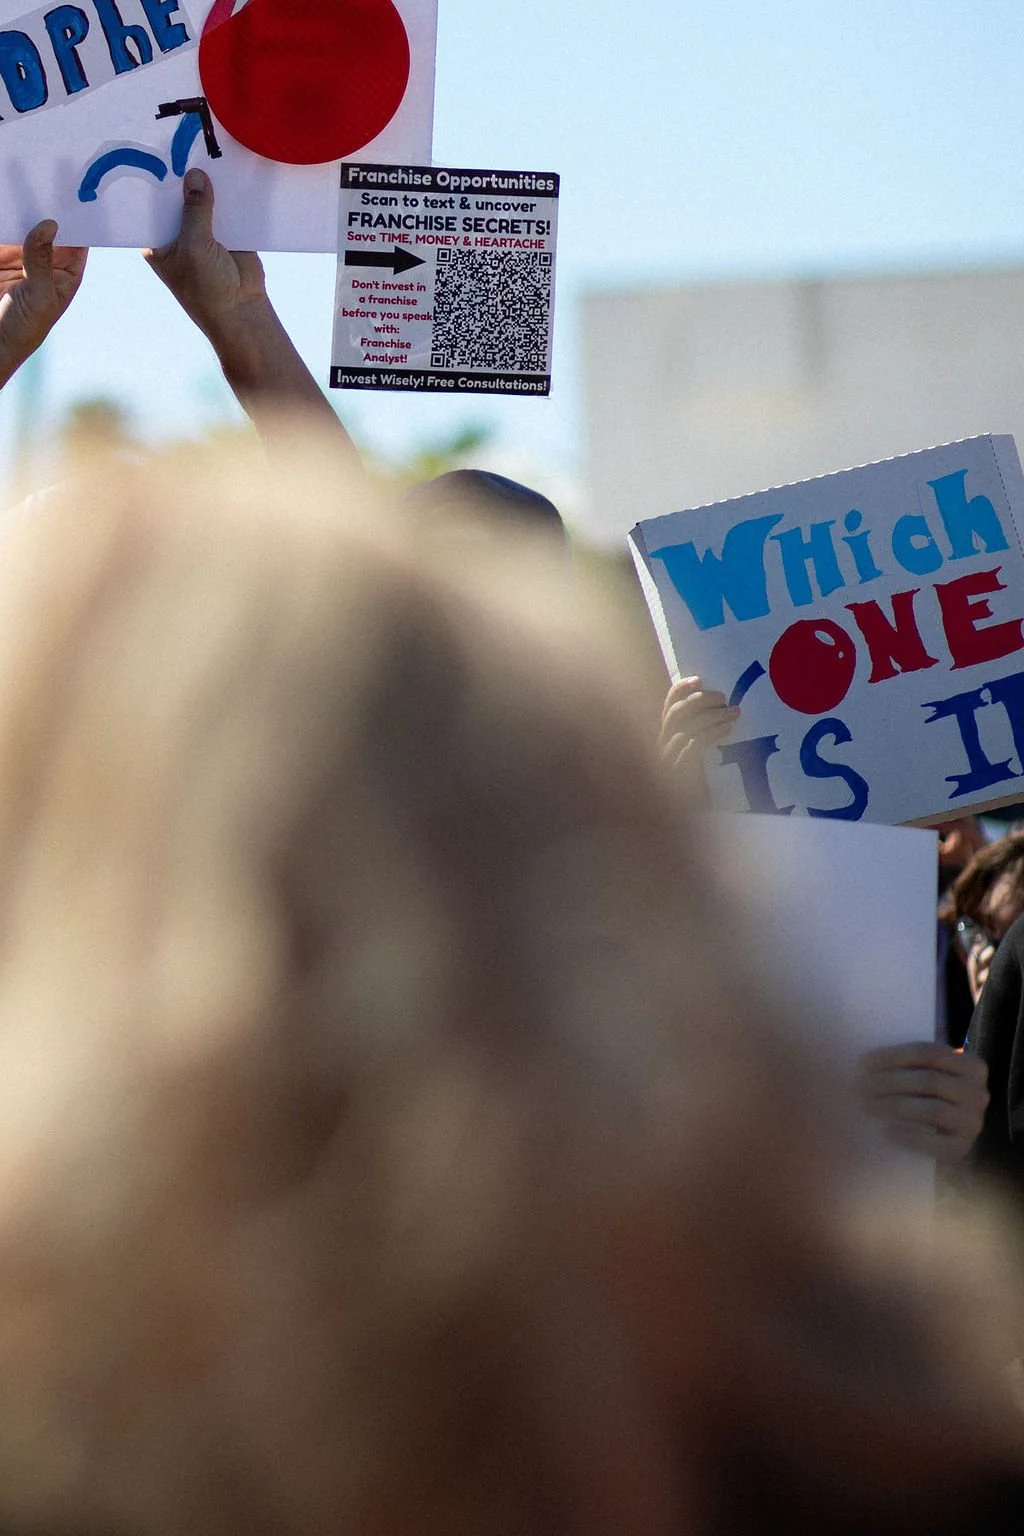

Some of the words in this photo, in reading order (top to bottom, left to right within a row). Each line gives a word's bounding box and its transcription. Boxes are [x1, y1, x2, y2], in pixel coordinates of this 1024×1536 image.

[348, 167, 432, 186] Franchise
[436, 171, 555, 191] Opportunities
[361, 193, 398, 207] Scan
[402, 196, 419, 207] to
[422, 196, 455, 209] text
[459, 197, 471, 210] &
[475, 199, 536, 213] uncover
[347, 212, 457, 232] FRANCHISE
[462, 217, 551, 235] SECRETS!
[347, 231, 376, 242] Save
[379, 232, 412, 245] TIME,
[415, 235, 460, 246] MONEY
[462, 236, 472, 246] &
[474, 237, 545, 249] HEARTACHE
[351, 279, 380, 290] Don't
[381, 281, 415, 292] invest
[416, 282, 426, 292] in
[358, 295, 367, 304] a
[368, 295, 418, 306] franchise
[342, 308, 377, 319] before
[379, 312, 400, 321] you
[402, 312, 433, 322] speak
[374, 324, 400, 334] with:
[360, 337, 412, 349] Franchise
[363, 352, 408, 364] Analyst!
[337, 369, 377, 385] Invest
[380, 373, 425, 387] Wisely!
[427, 375, 455, 387] Free
[458, 378, 547, 391] Consultations!
[718, 717, 870, 822] IS
